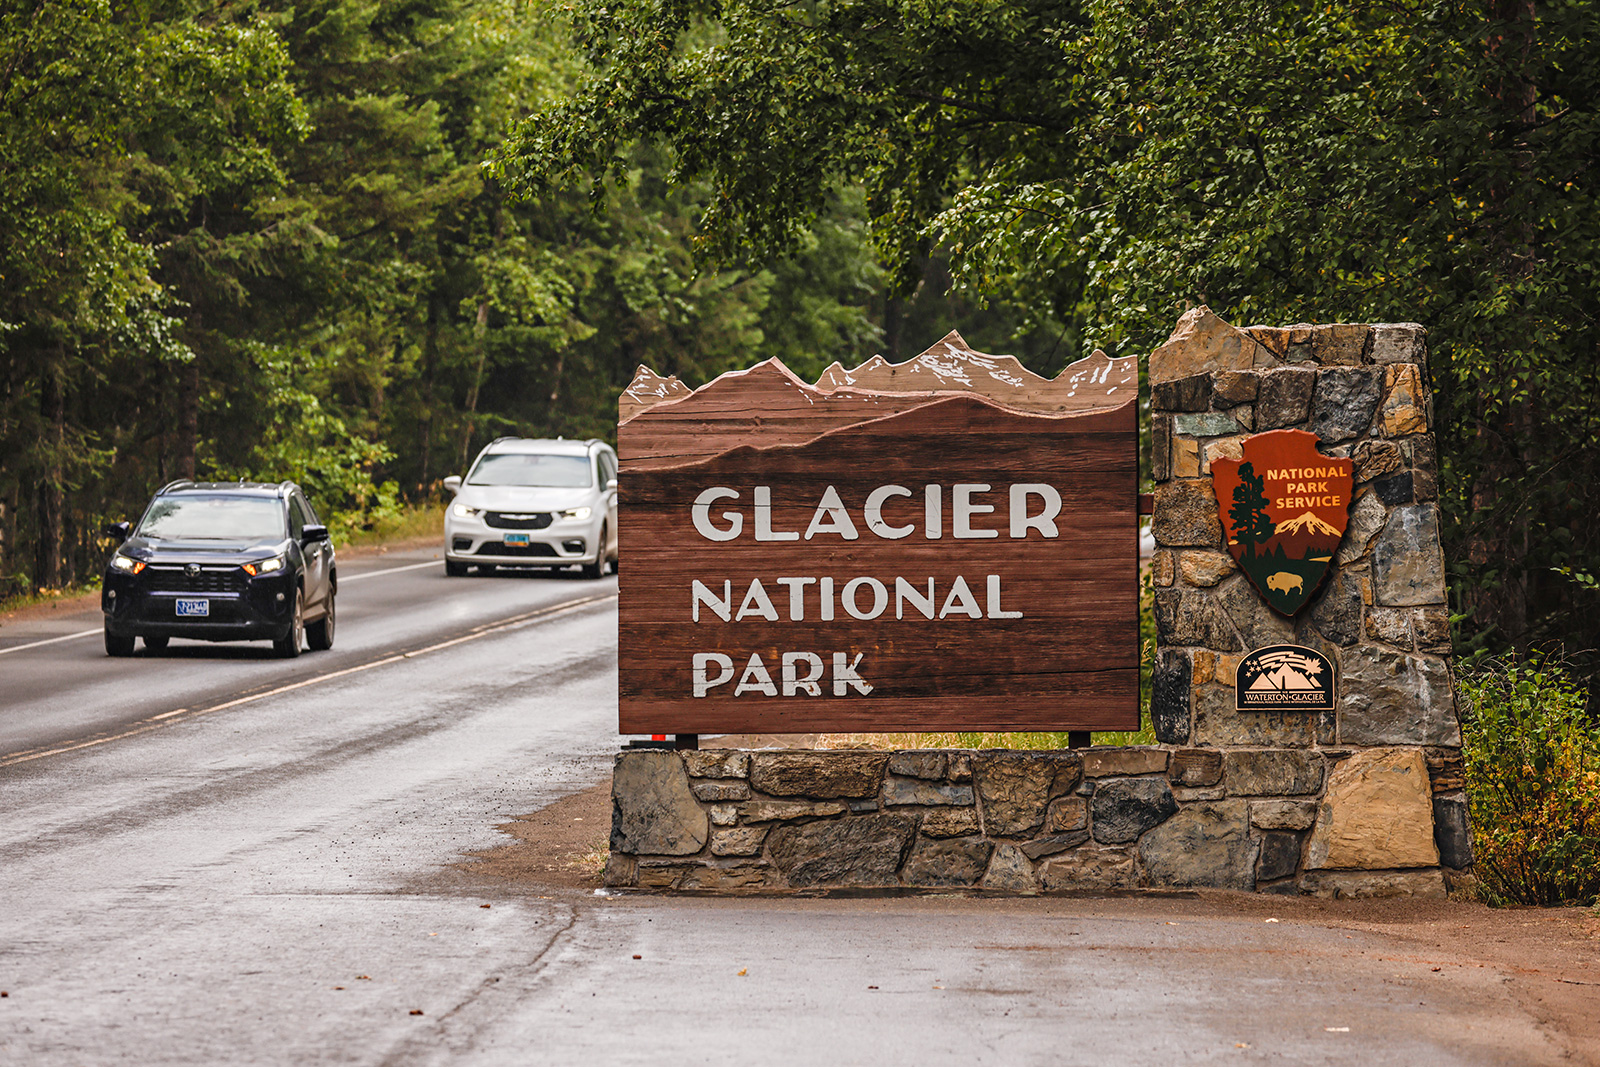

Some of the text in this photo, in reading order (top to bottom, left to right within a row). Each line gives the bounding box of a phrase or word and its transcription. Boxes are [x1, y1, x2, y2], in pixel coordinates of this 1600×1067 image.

[1267, 466, 1347, 480] NATIONAL
[1286, 481, 1328, 494] PARK
[691, 484, 1062, 542] GLACIER
[1275, 495, 1340, 509] SERVICE
[692, 575, 1023, 622] NATIONAL
[692, 652, 874, 698] PARK
